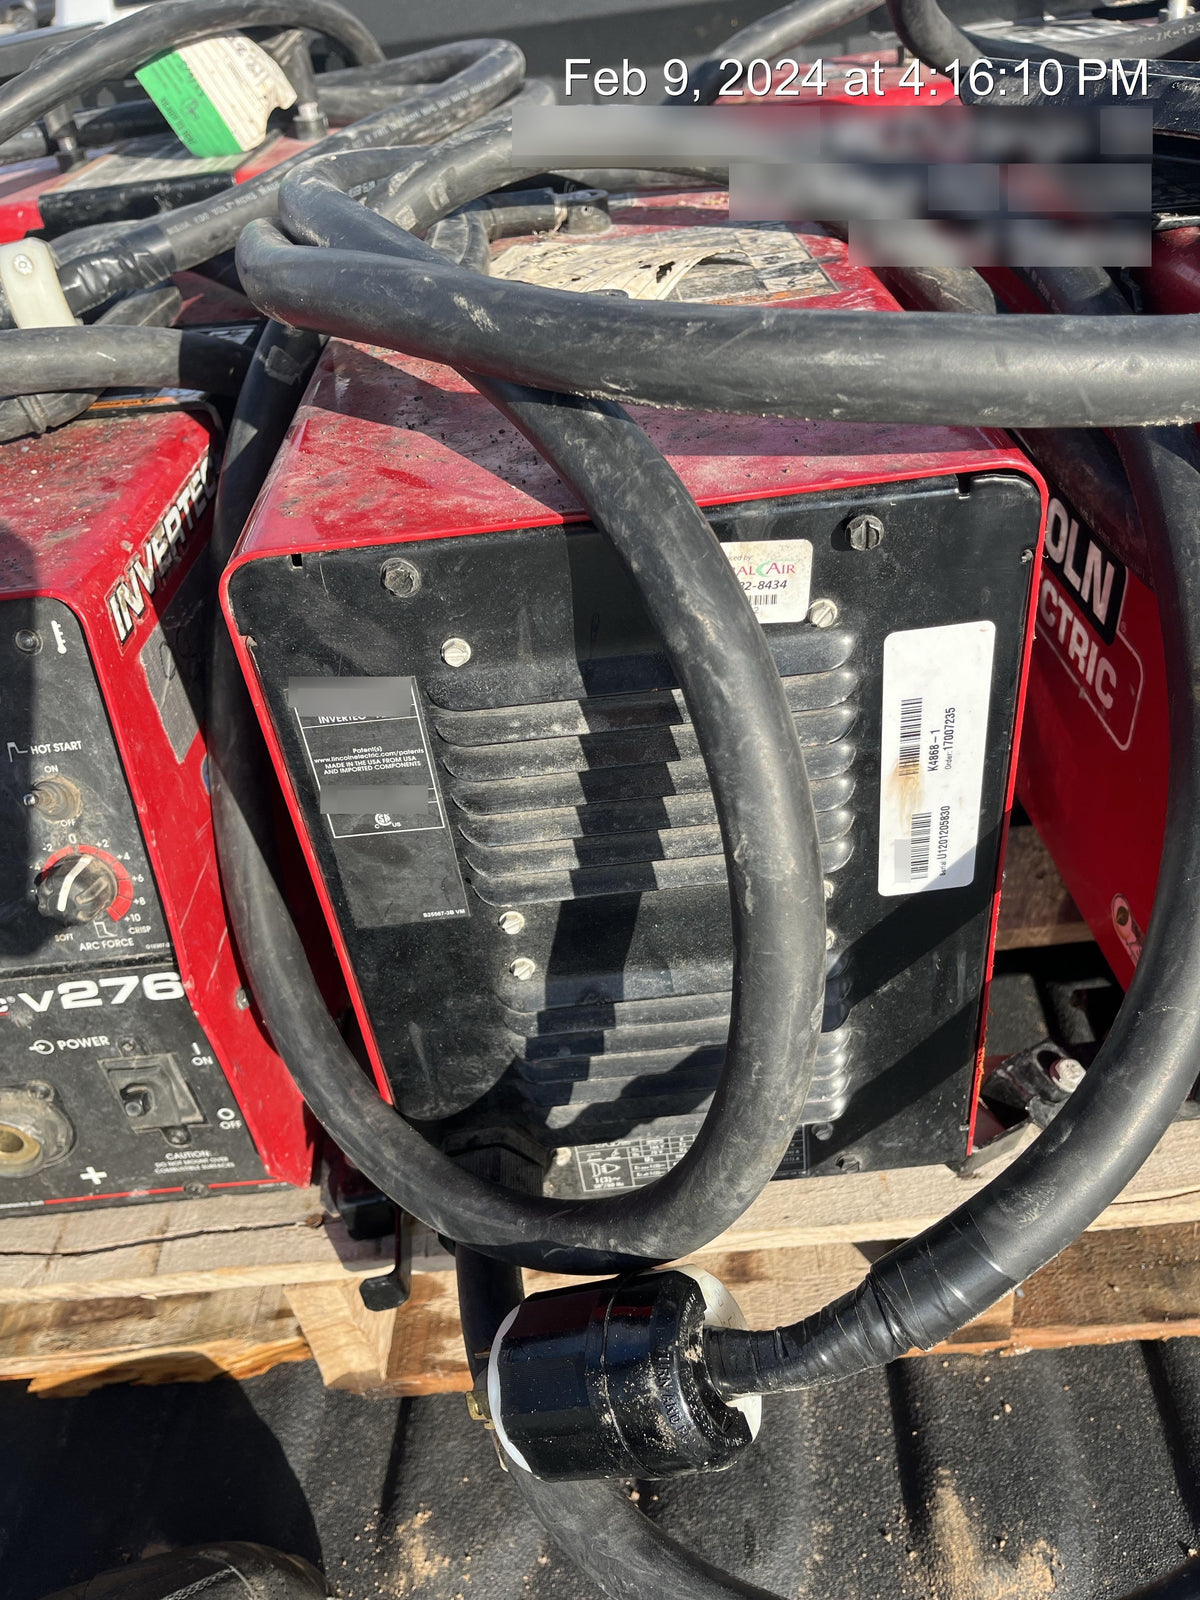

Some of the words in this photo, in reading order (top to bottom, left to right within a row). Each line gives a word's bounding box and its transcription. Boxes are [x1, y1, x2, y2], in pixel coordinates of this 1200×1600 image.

[30, 744, 51, 755] HOT
[53, 741, 82, 753] START
[352, 746, 383, 754] Patent(s)
[313, 748, 425, 764] www.lincolnelectric.com/patents
[44, 765, 59, 774] ON
[340, 765, 374, 773] IMPORTED
[374, 761, 422, 771] COMPONENTS
[61, 819, 76, 827] OFF
[68, 833, 77, 844] 0
[96, 839, 109, 848] +2
[42, 844, 53, 853] -2
[116, 852, 130, 861] +4
[132, 874, 144, 883] +6
[133, 897, 146, 906] +8
[124, 913, 141, 923] +10
[128, 925, 151, 935] CRISP
[54, 932, 74, 942] SOFT
[80, 941, 101, 952] ARC
[102, 938, 135, 949] FORCE
[57, 1035, 110, 1051] POWER
[191, 1055, 213, 1066] ON
[219, 1120, 242, 1130] OFF
[165, 1150, 209, 1160] CAUTION
